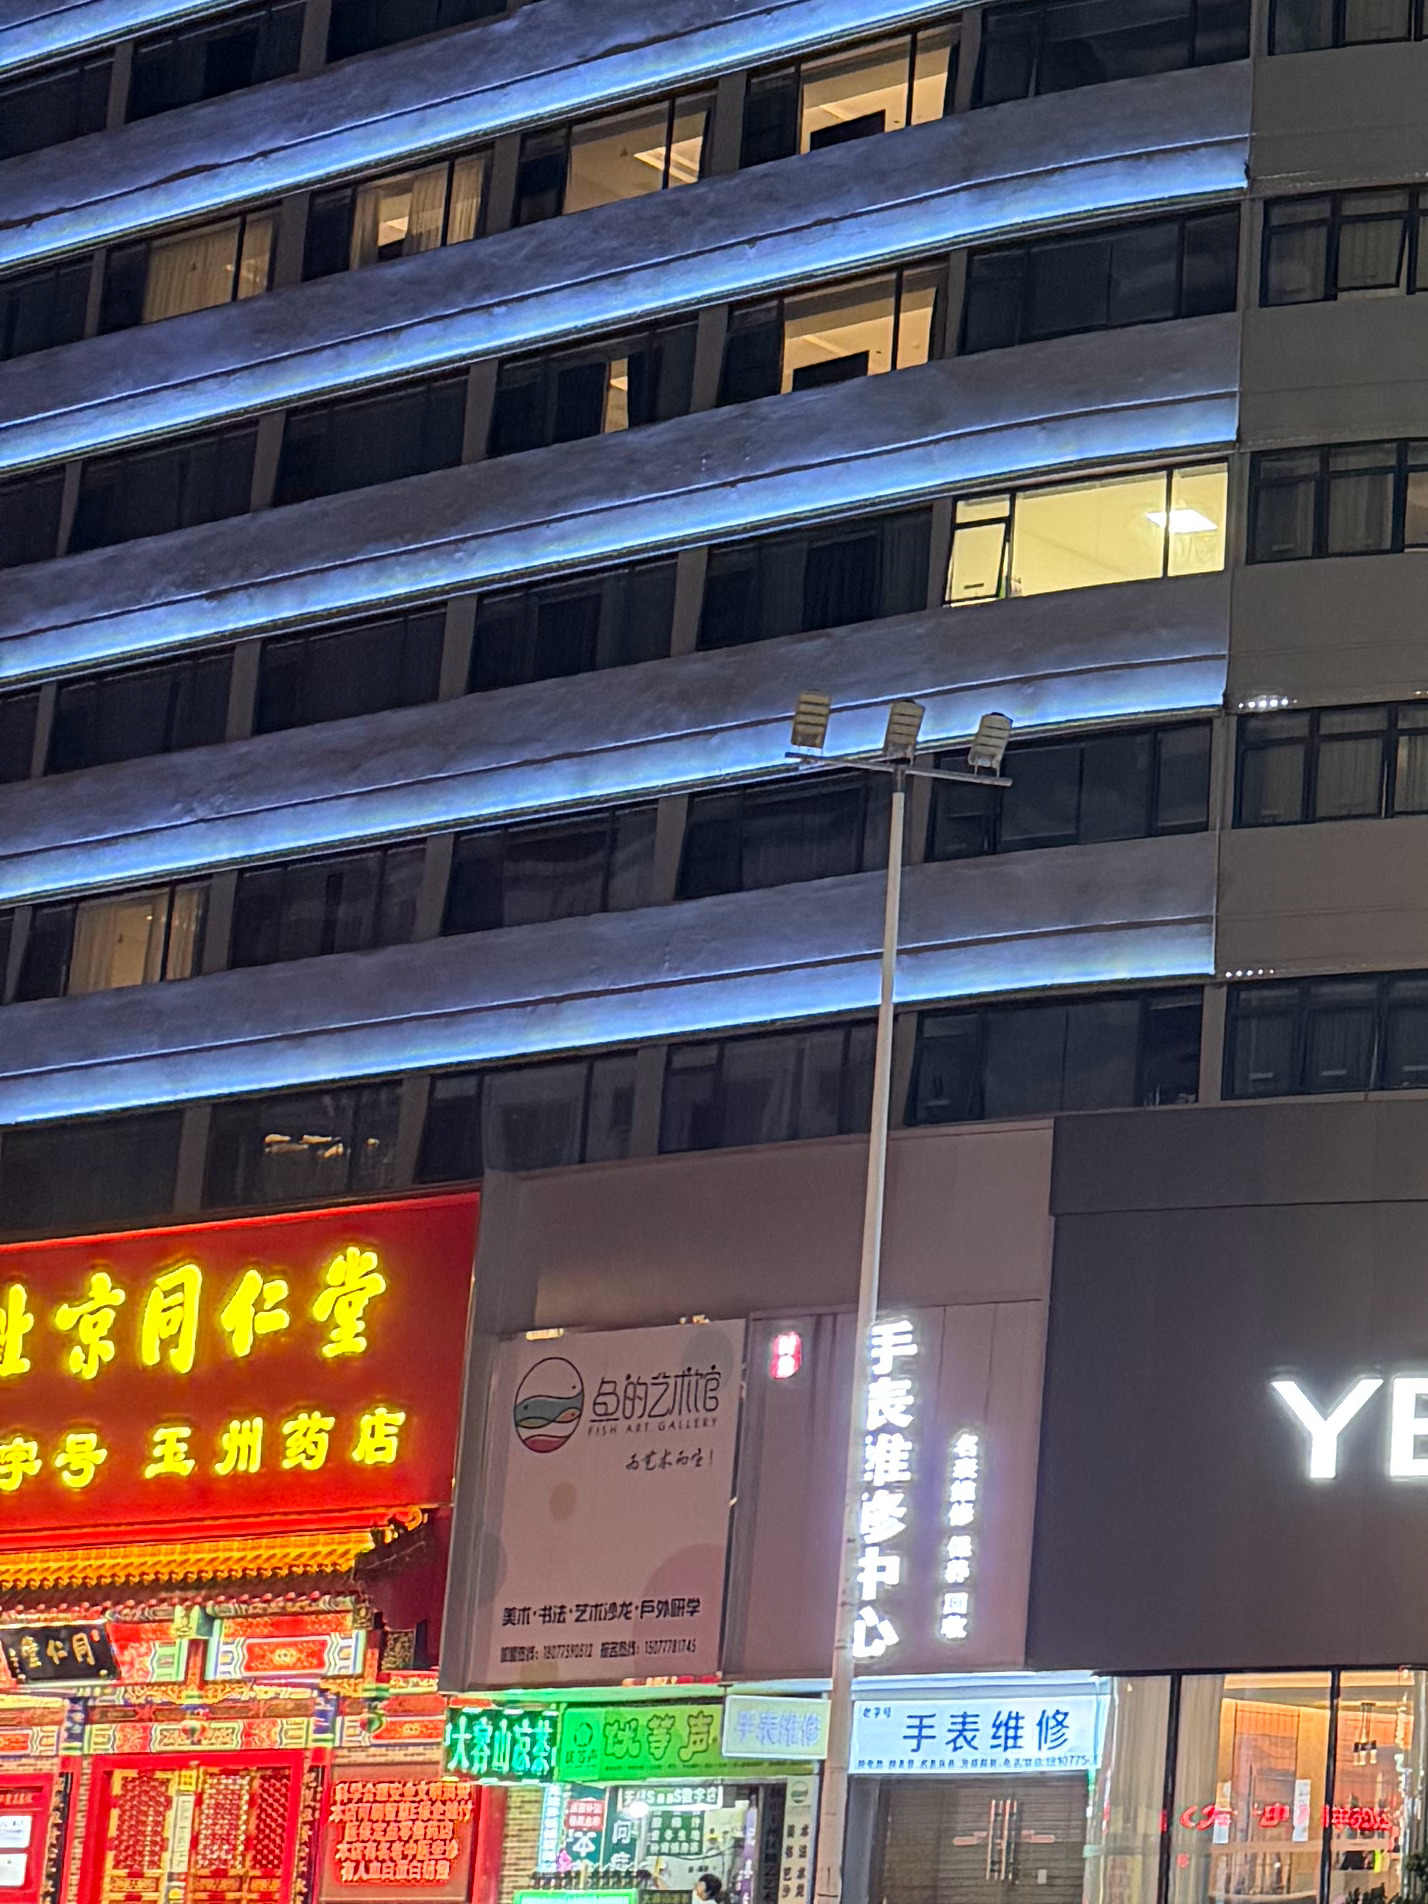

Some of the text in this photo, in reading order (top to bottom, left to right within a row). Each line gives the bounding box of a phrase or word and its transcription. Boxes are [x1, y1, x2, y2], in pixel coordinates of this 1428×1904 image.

[591, 1364, 722, 1423] 鱼的艺术馆
[144, 1407, 407, 1480] 玉州药店
[587, 1416, 718, 1437] FISH ART GALLERY
[852, 1319, 918, 1659] 手表维修中心
[734, 1709, 821, 1747] 手表维修
[902, 1708, 1070, 1753] 手表维修
